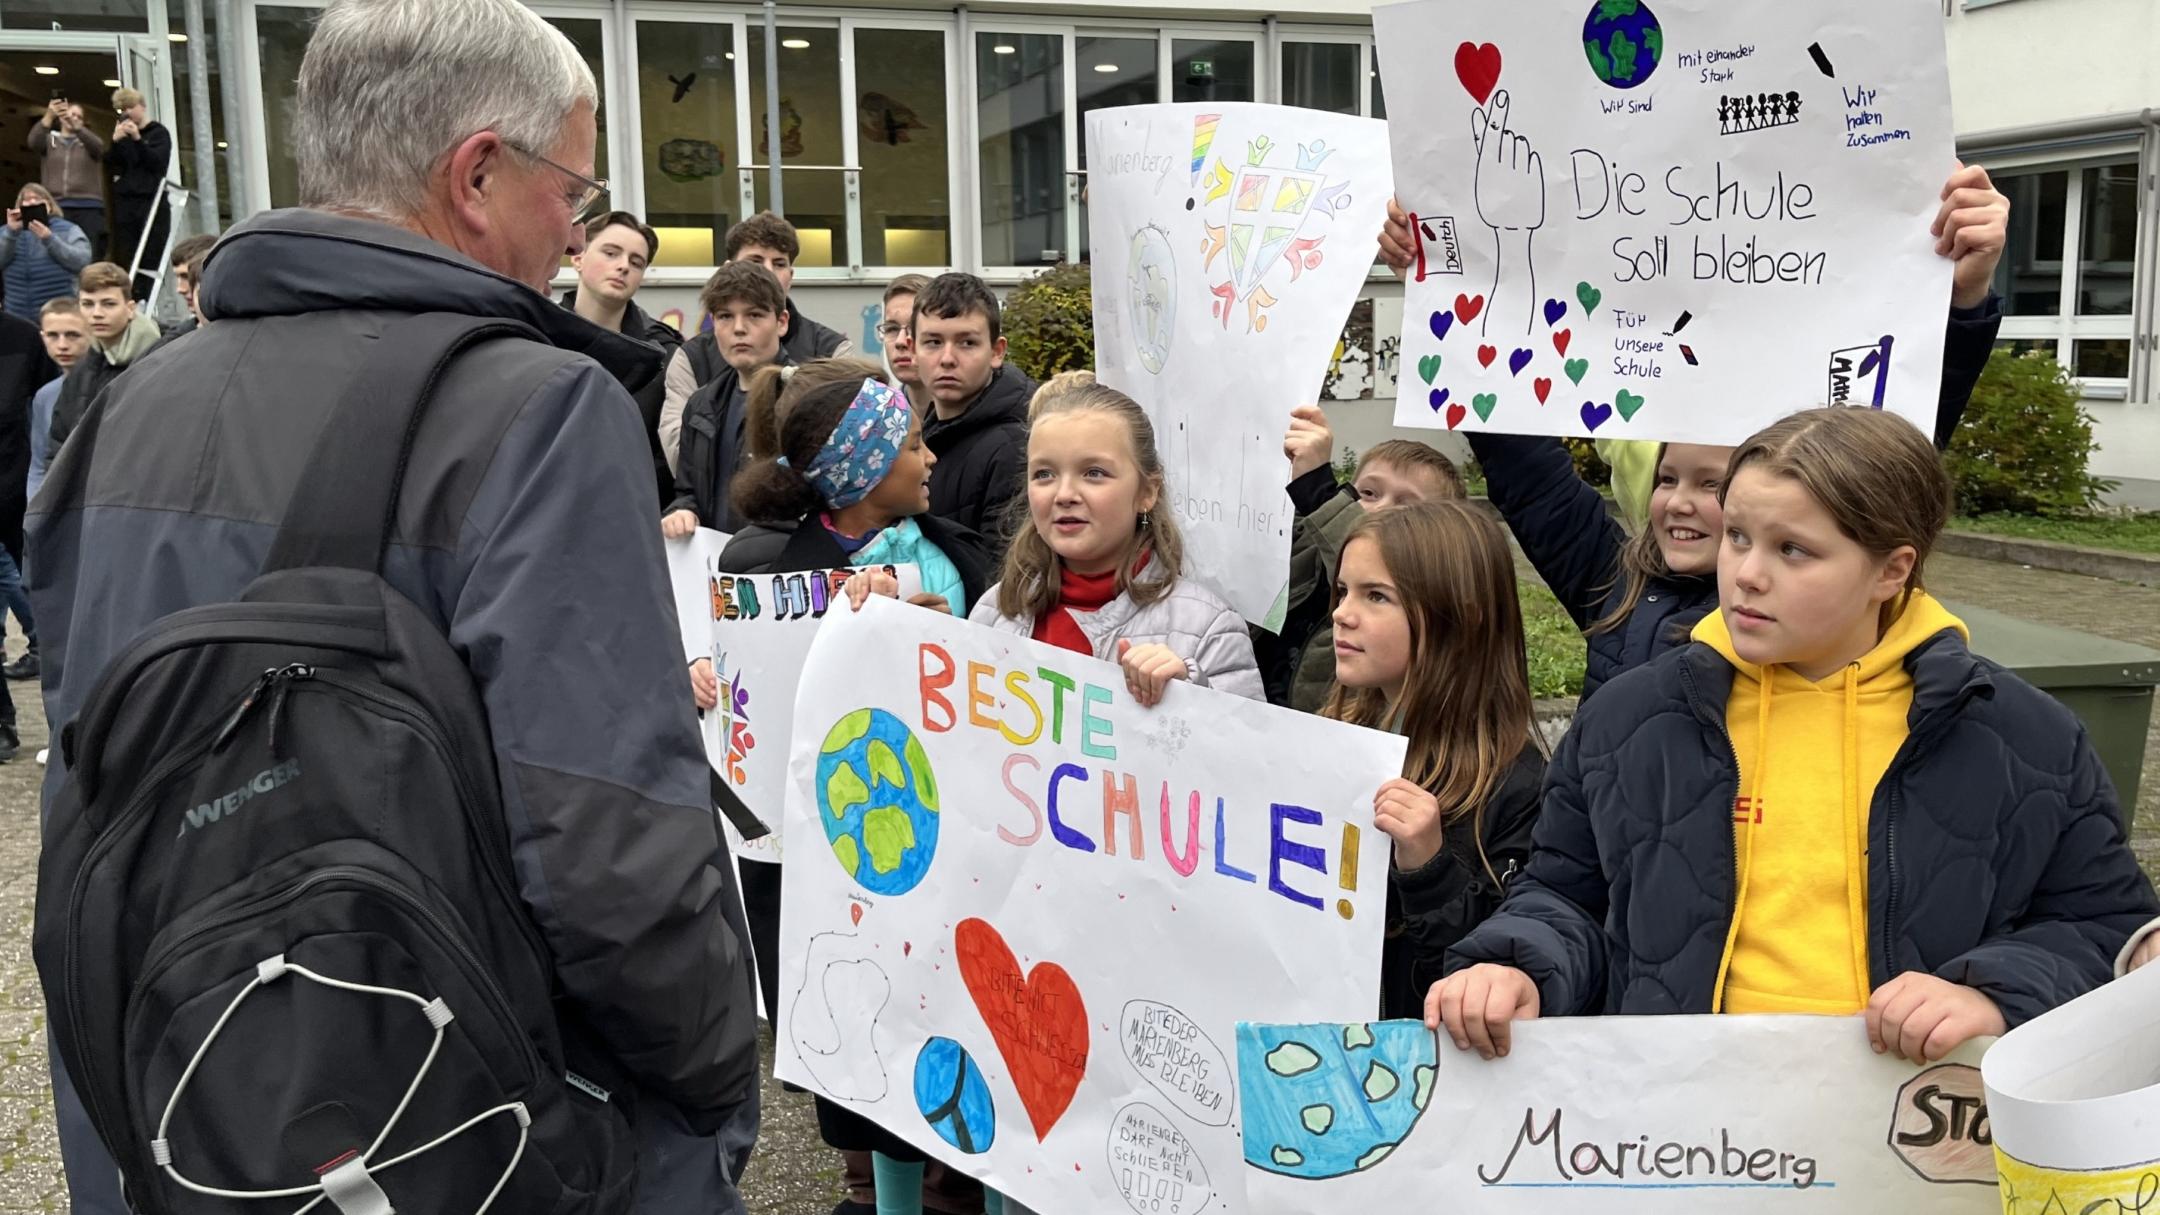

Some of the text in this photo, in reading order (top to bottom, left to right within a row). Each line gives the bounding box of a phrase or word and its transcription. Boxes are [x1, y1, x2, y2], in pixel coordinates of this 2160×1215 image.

[1600, 98, 1624, 114] Wir
[1842, 85, 1876, 108] Wir
[1845, 111, 1882, 131] halten
[1570, 148, 1816, 225] Die Schule
[1612, 233, 1826, 285] Soll bleiben
[1612, 309, 1646, 329] Für
[1613, 356, 1662, 378] Schule
[919, 642, 1117, 761] BESTE
[185, 757, 301, 829] WENGER
[997, 752, 1361, 921] SCHULE!
[1896, 1084, 1993, 1148] STO
[1477, 1106, 1816, 1190] Marienberg
